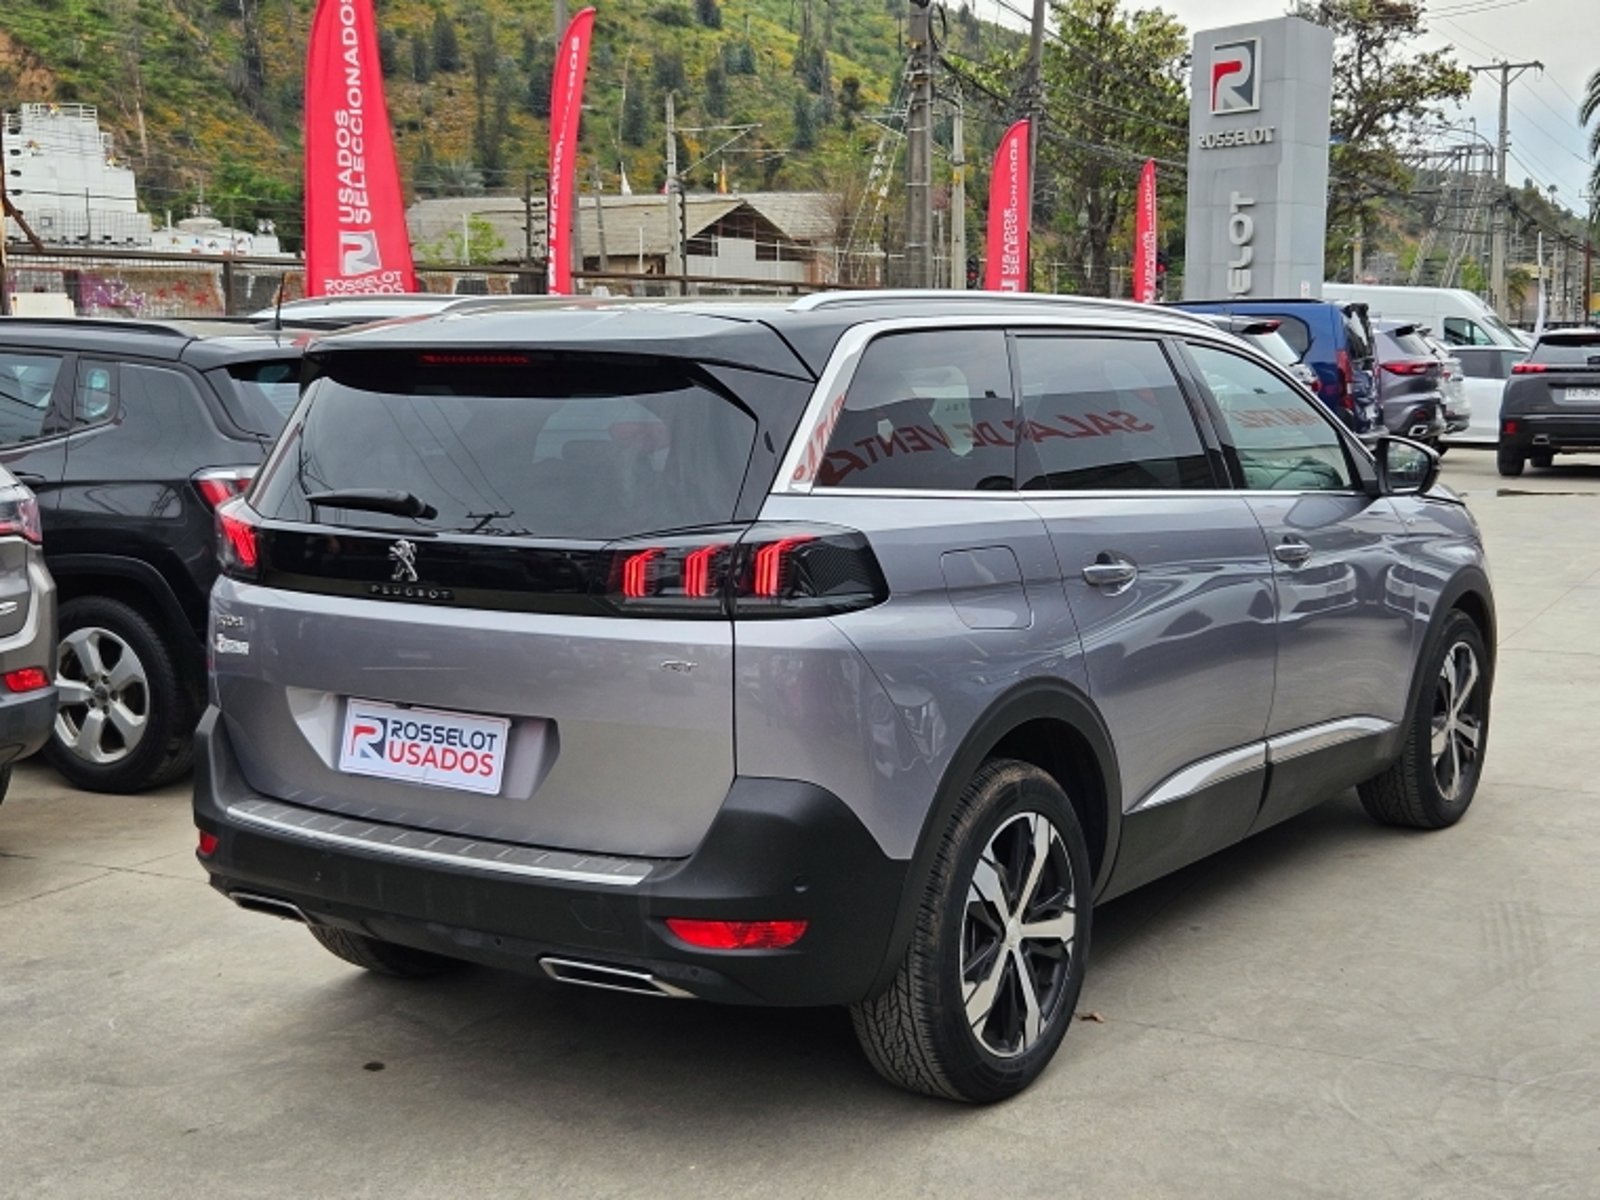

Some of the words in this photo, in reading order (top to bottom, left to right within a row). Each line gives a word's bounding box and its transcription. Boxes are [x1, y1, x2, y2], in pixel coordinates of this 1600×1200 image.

[340, 0, 371, 224] SELECCIONADO
[335, 110, 355, 223] USADOS
[1226, 191, 1255, 299] ELOT
[371, 585, 450, 599] PEUGEOT
[388, 740, 494, 777] USADOS
[390, 719, 498, 752] ROSSELOT
